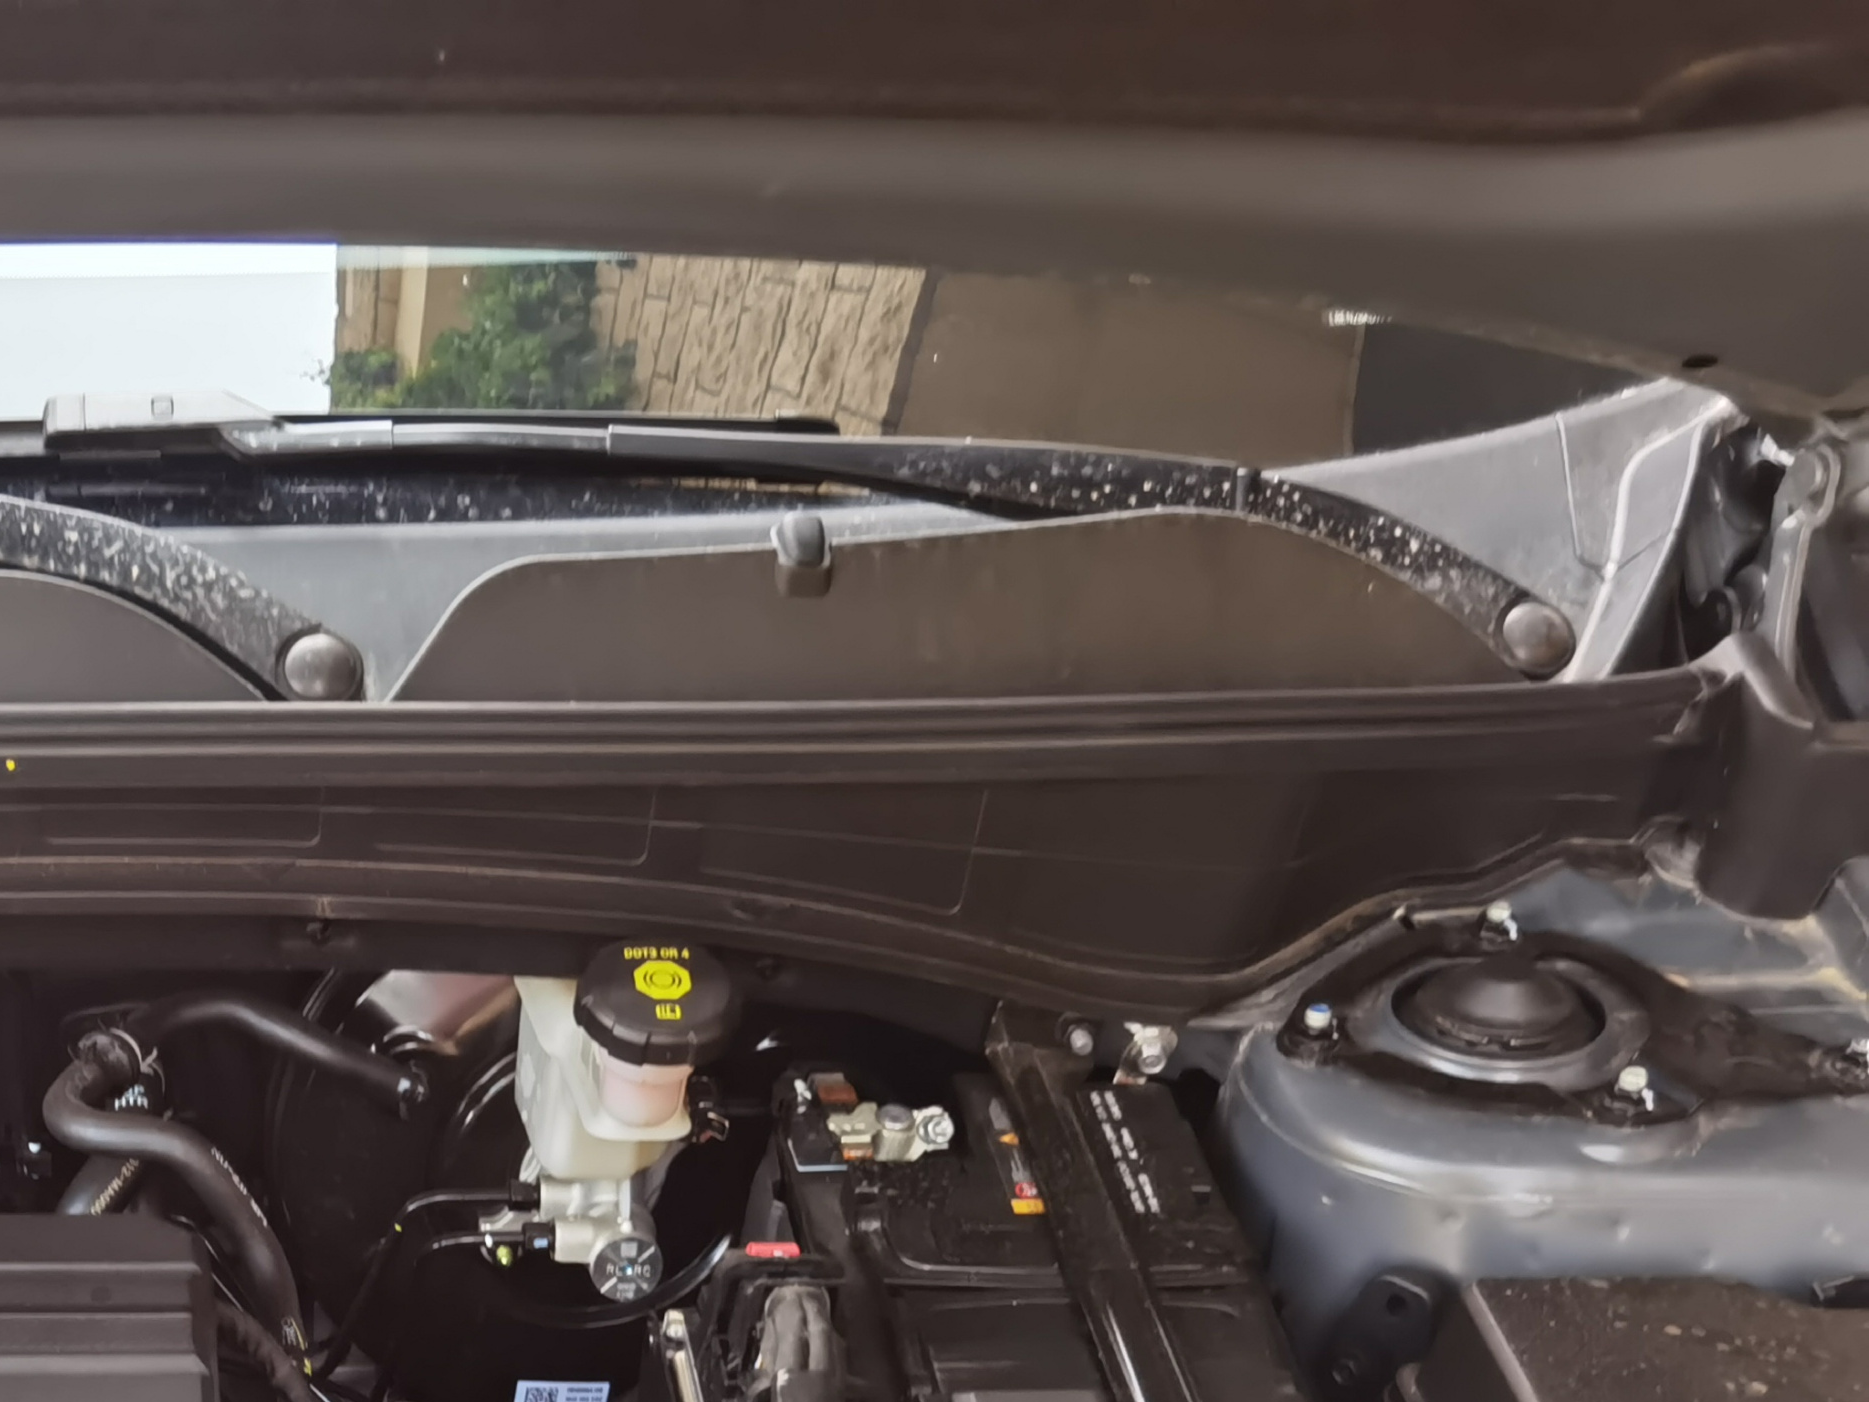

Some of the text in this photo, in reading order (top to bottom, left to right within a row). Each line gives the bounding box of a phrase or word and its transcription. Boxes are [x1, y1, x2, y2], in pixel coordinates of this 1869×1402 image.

[623, 946, 690, 960] DOT3 OR 4
